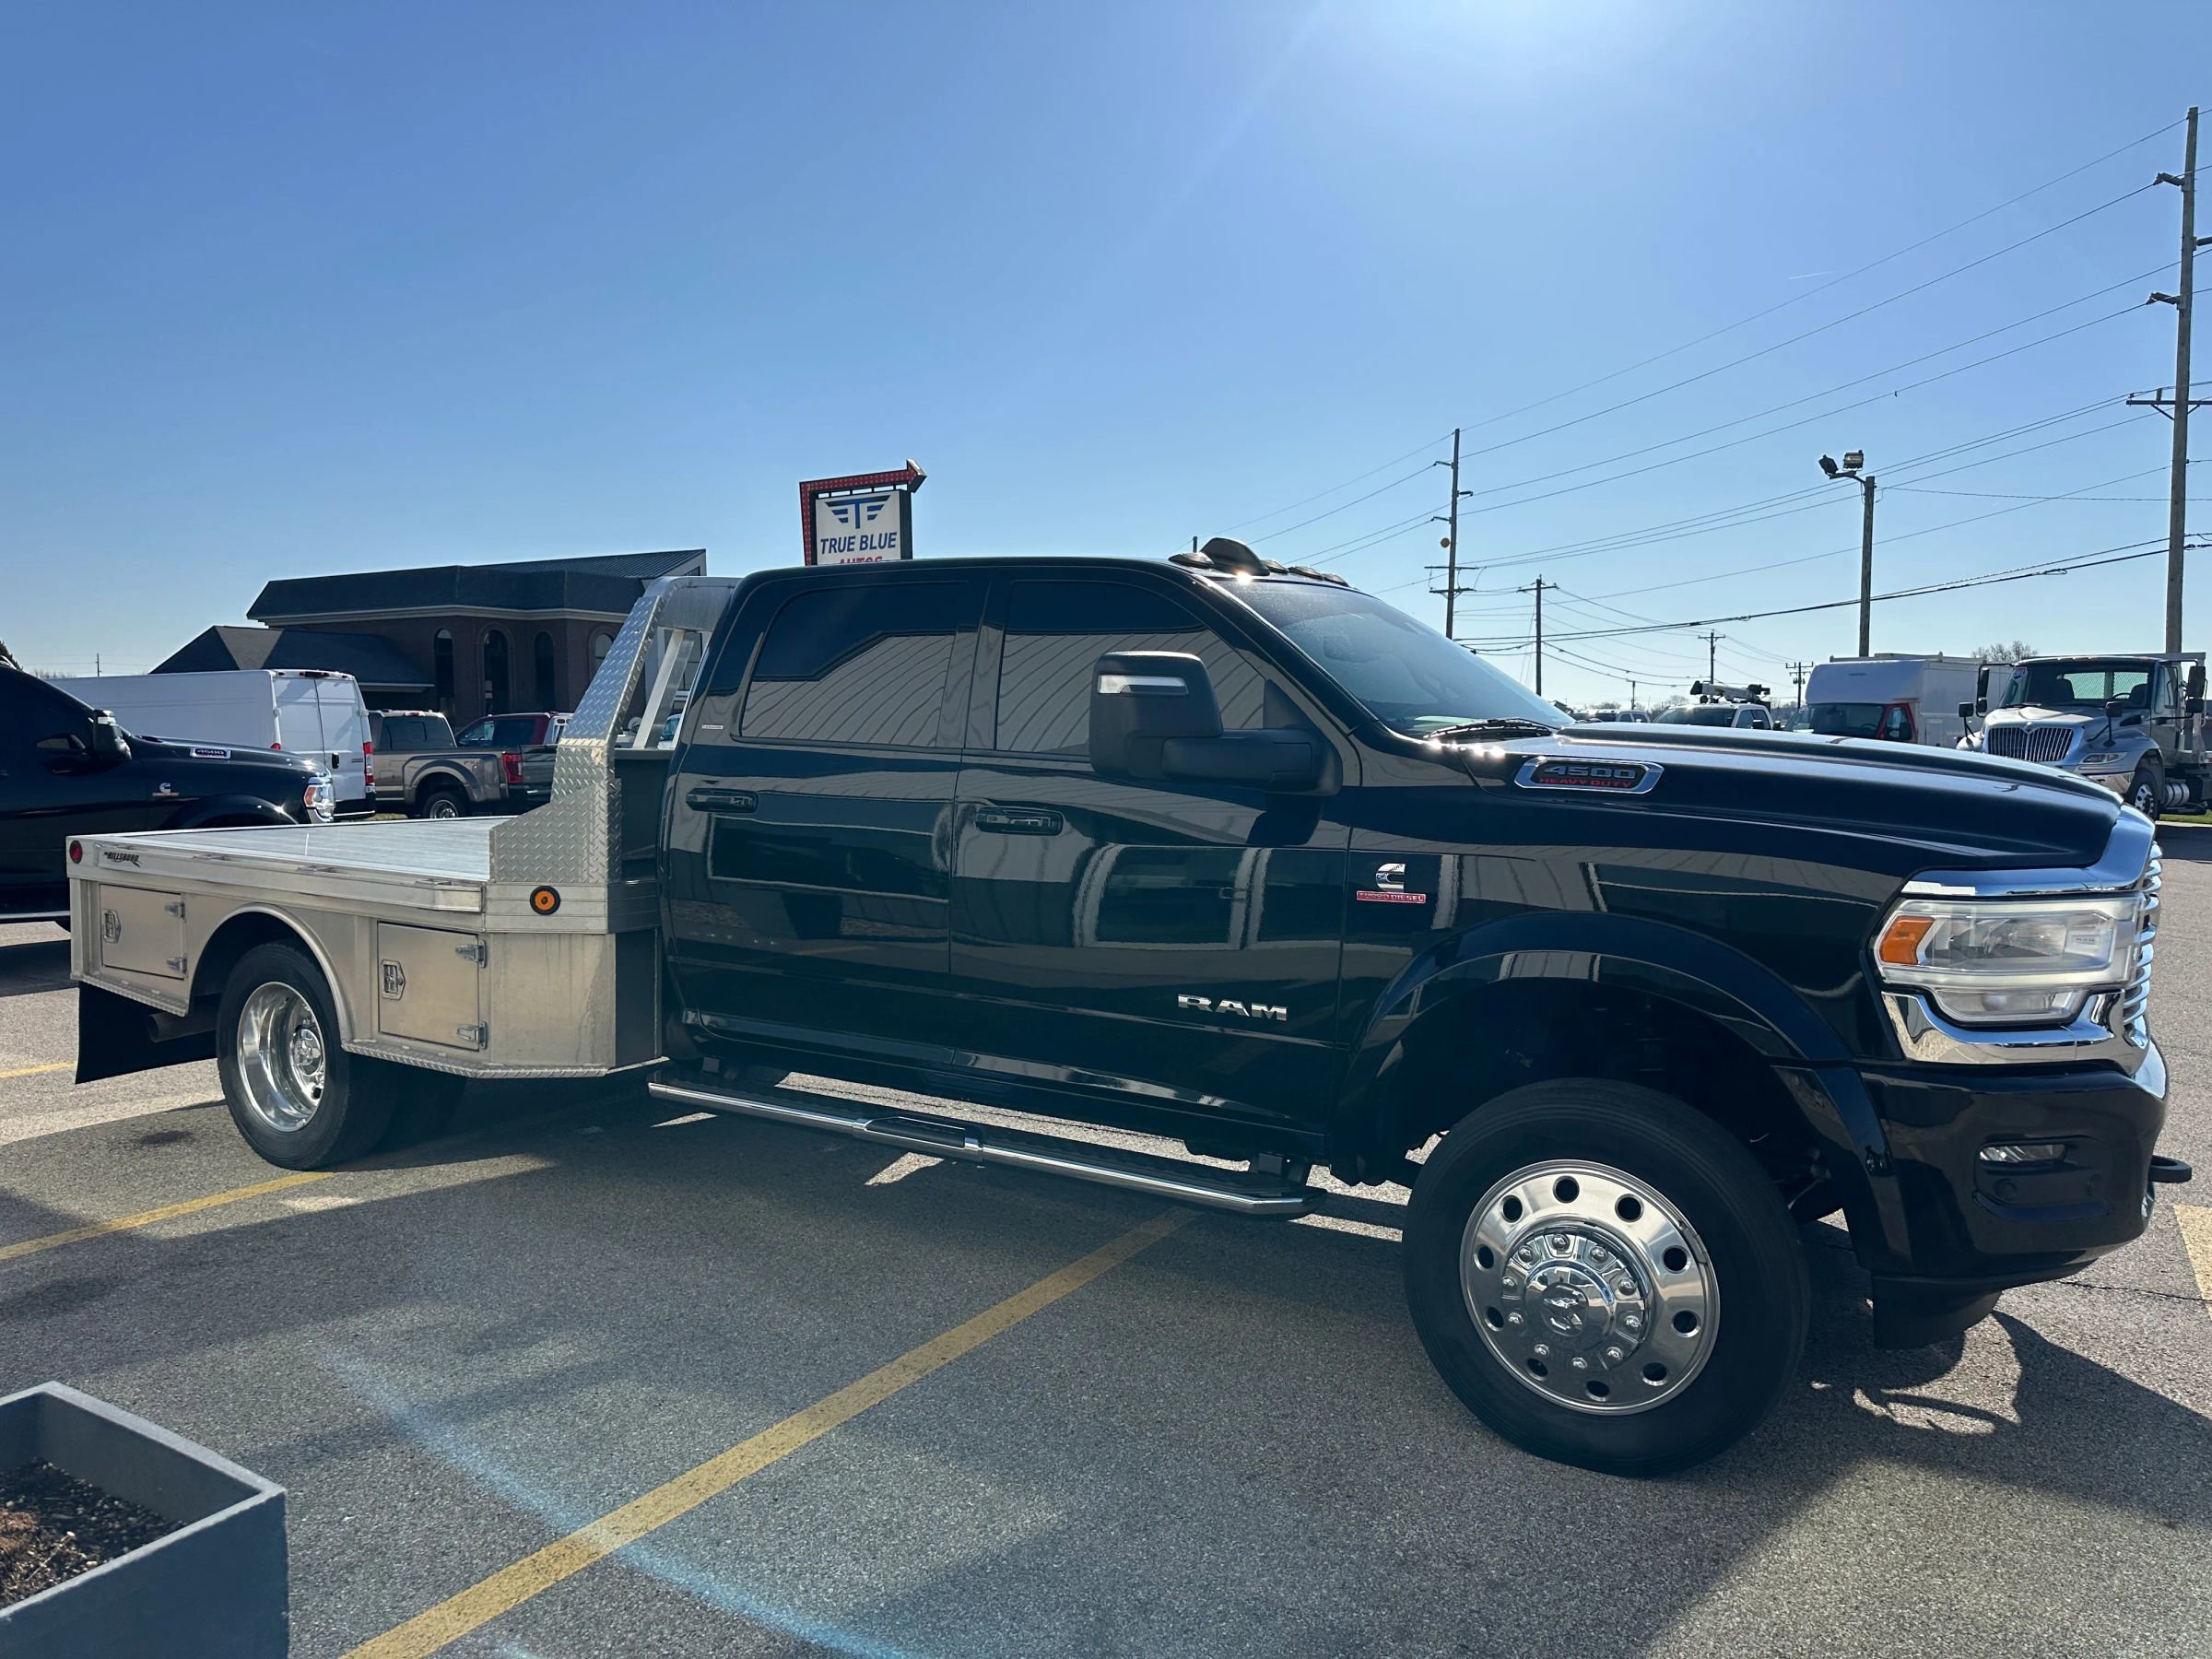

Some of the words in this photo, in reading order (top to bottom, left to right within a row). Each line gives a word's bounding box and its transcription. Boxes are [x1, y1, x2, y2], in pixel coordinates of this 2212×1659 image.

[820, 535, 856, 554] TRUE
[859, 532, 898, 550] BLUE
[1544, 765, 1636, 779] 4500
[1589, 780, 1632, 788] DUTY
[1178, 994, 1288, 1021] RAM
